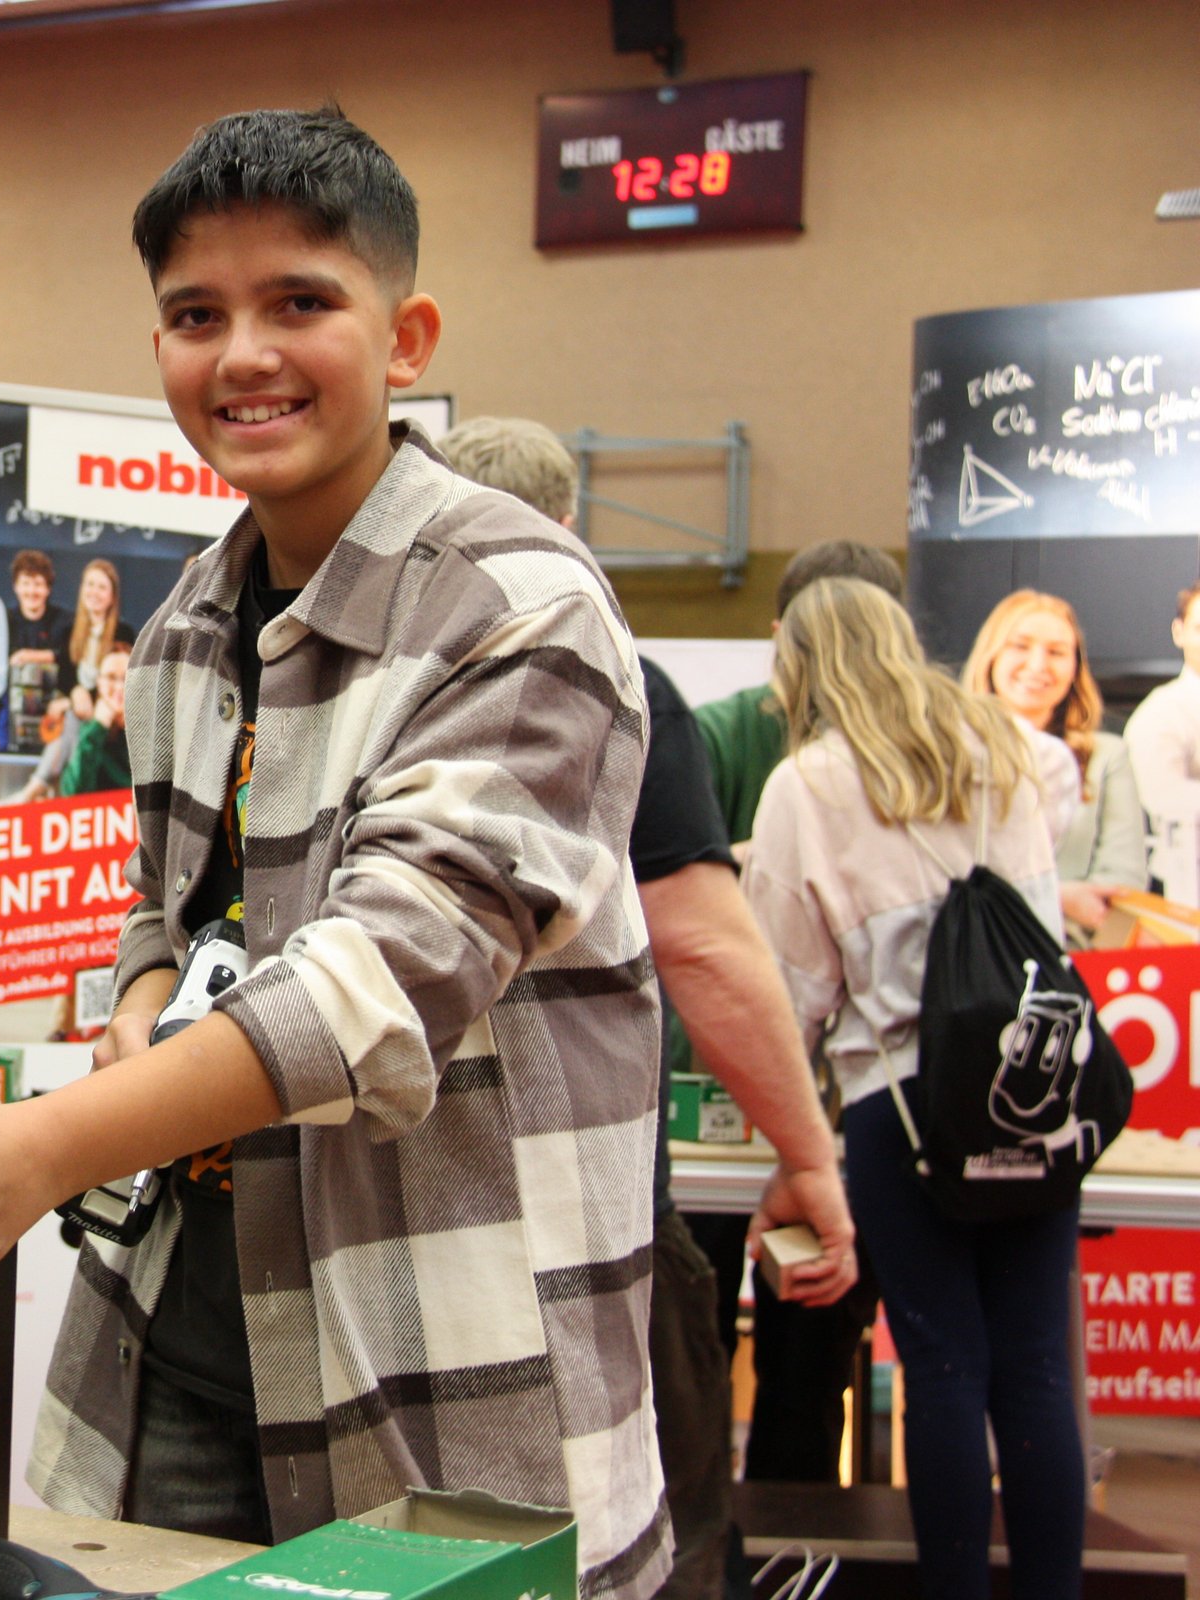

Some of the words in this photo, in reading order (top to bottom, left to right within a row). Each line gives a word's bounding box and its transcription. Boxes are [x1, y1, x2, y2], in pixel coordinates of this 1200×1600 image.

[560, 135, 621, 168] HEIM
[704, 118, 783, 153] GÄSTE
[79, 452, 247, 500] nobi
[40, 802, 139, 854] DEIN
[5, 916, 95, 944] AUSBILDUNG
[1082, 1271, 1196, 1306] TARTE
[1085, 1319, 1151, 1354] EIM
